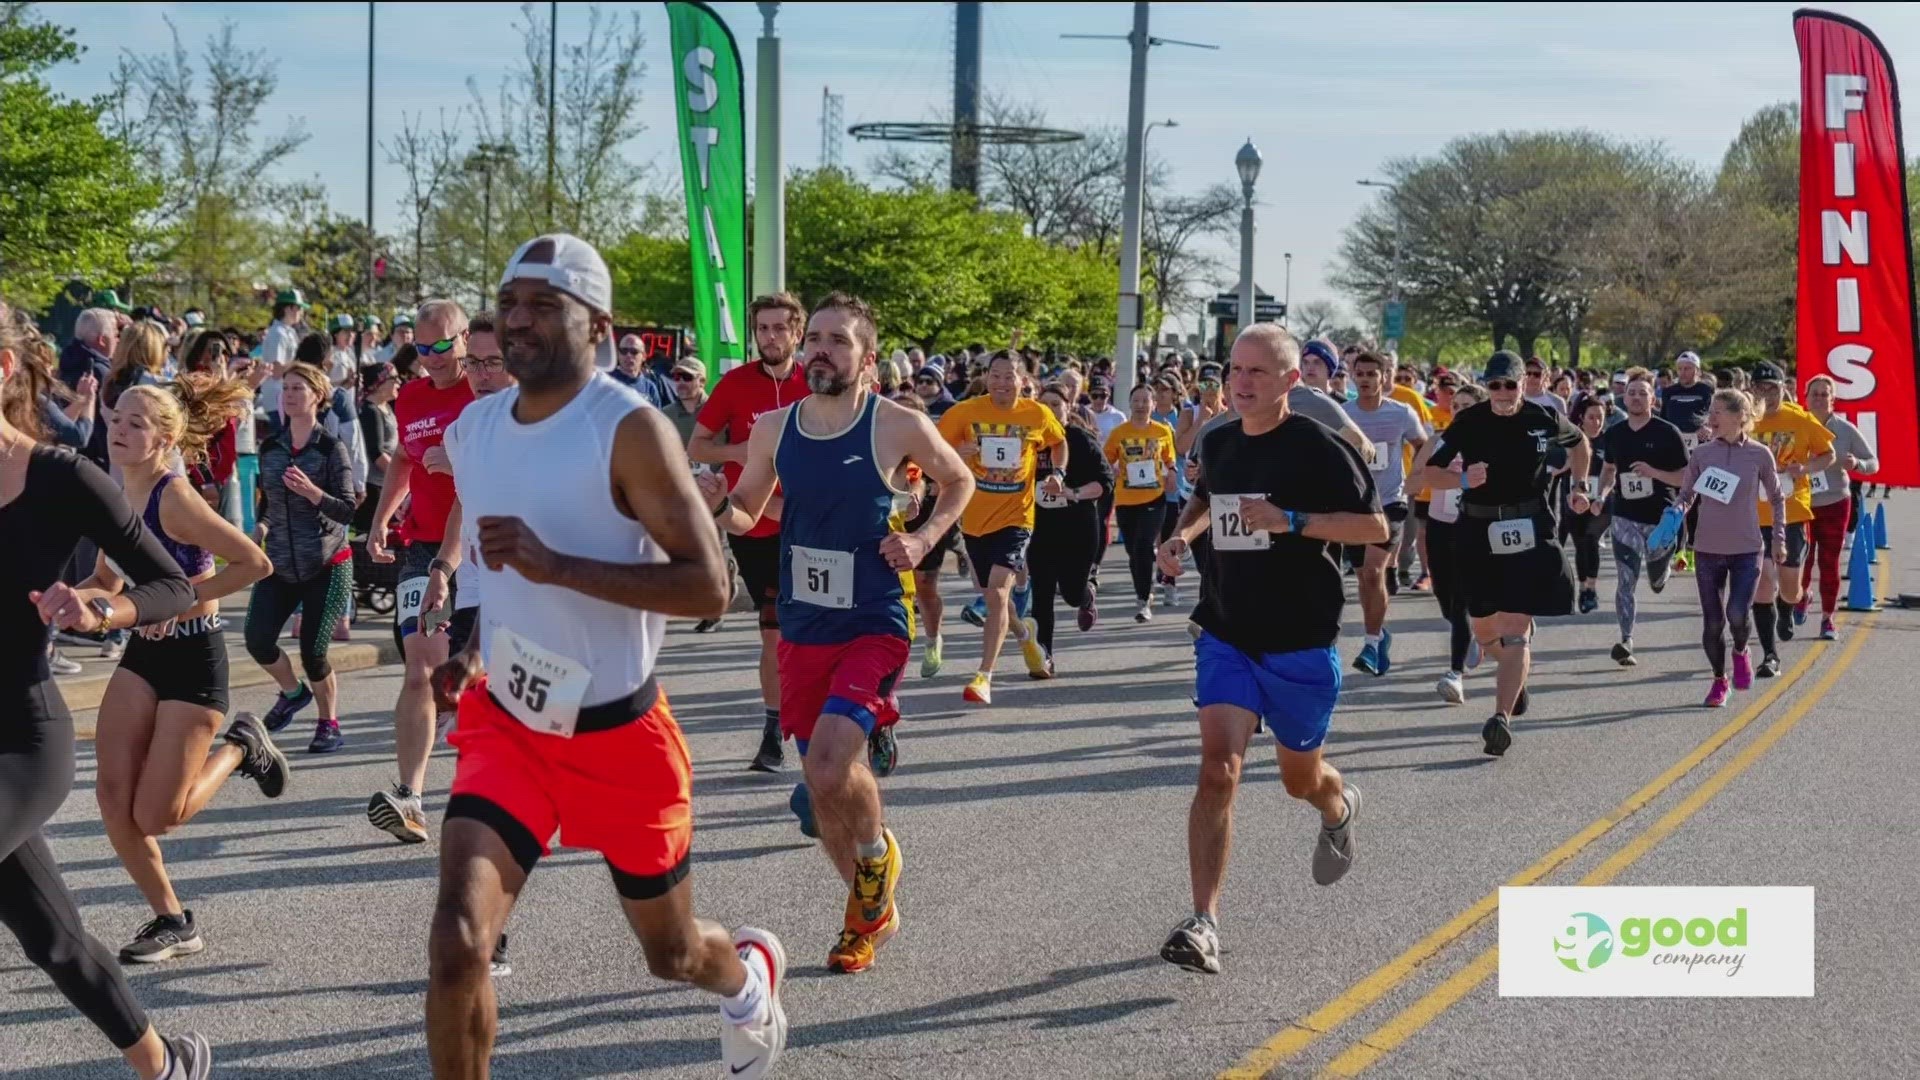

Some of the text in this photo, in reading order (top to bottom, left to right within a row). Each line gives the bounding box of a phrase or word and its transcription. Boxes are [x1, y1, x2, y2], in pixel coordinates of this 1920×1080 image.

[996, 447, 1005, 461] 5
[1138, 469, 1146, 479] 4
[1704, 475, 1728, 494] 162
[1502, 530, 1521, 546] 63
[807, 566, 829, 595] 51
[402, 590, 421, 609] 49
[508, 662, 551, 713] 35
